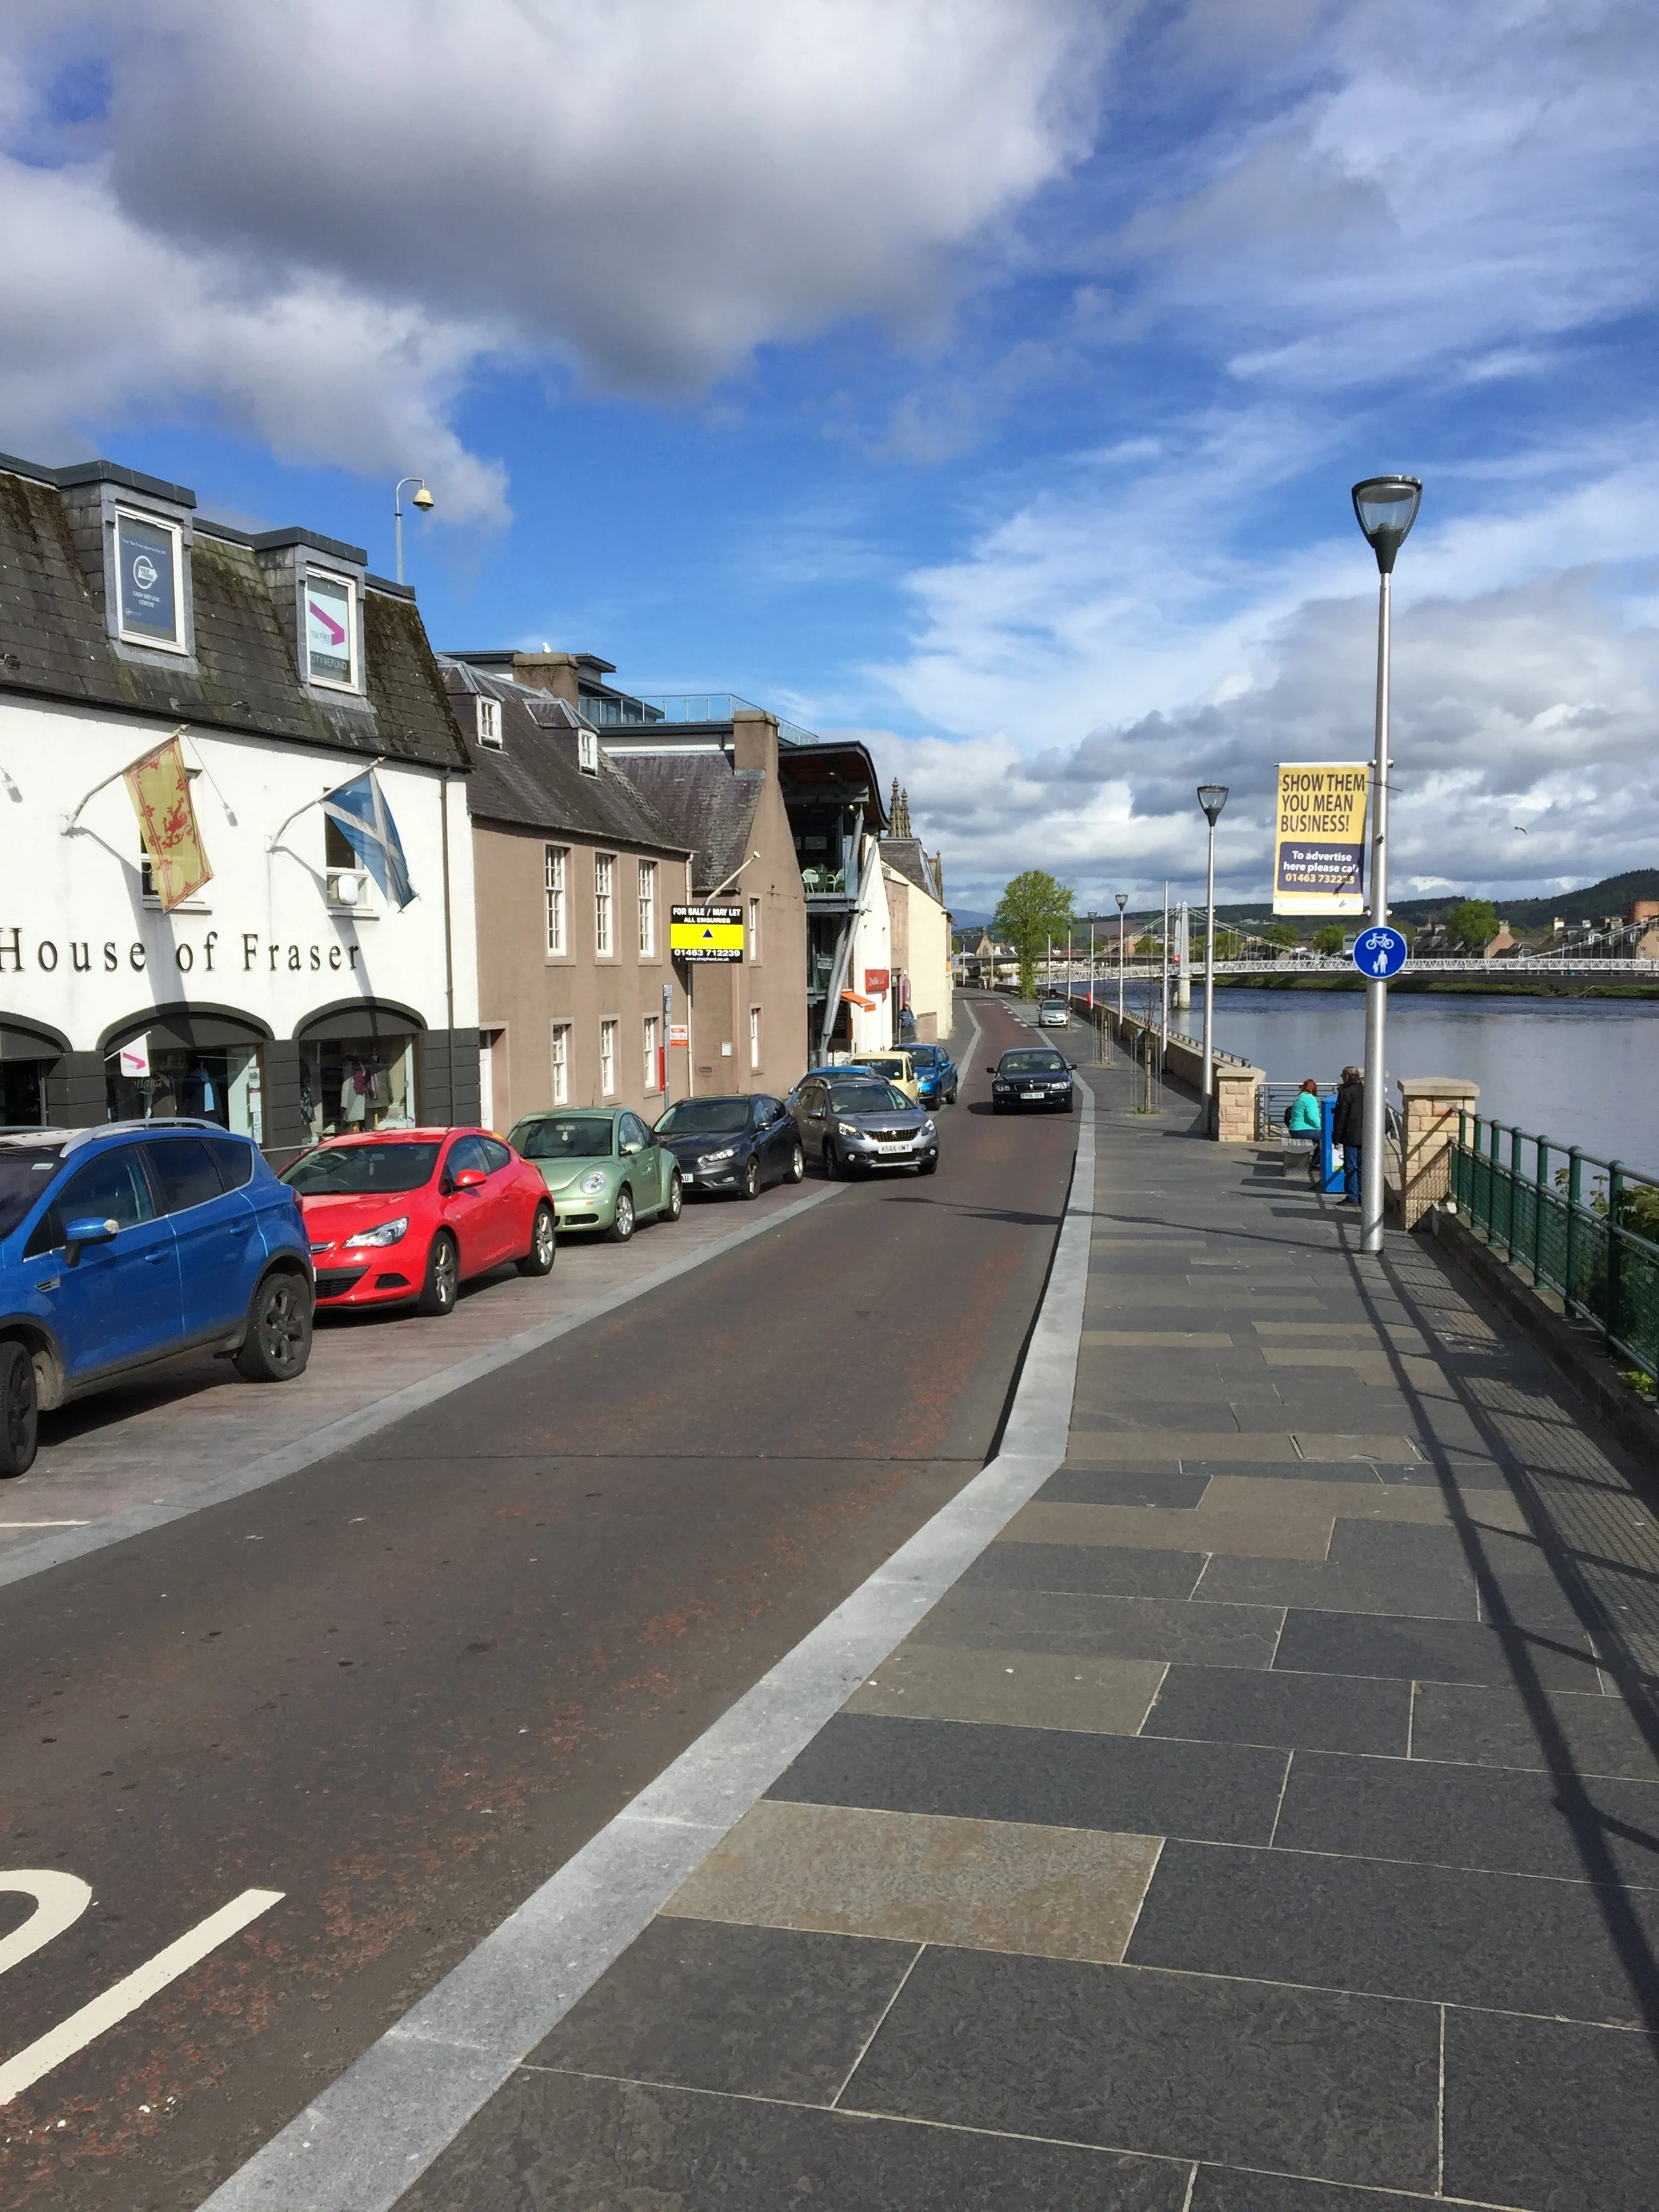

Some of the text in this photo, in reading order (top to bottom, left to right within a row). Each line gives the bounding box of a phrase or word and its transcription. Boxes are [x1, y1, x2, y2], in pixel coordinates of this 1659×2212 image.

[310, 630, 319, 639] TAX
[310, 655, 347, 670] CITY REFUND
[1282, 773, 1365, 792] SHOW THEM
[1282, 794, 1353, 812] YOU MEAN
[1281, 815, 1349, 832] BUSINESS!
[1292, 851, 1352, 862] To advertise
[1284, 861, 1305, 871] here
[1307, 862, 1339, 874] please
[1285, 873, 1315, 882] 01463
[673, 907, 686, 916] FOR
[706, 908, 710, 916] /
[713, 908, 727, 916] MAY
[0, 927, 359, 973] House of Fraser
